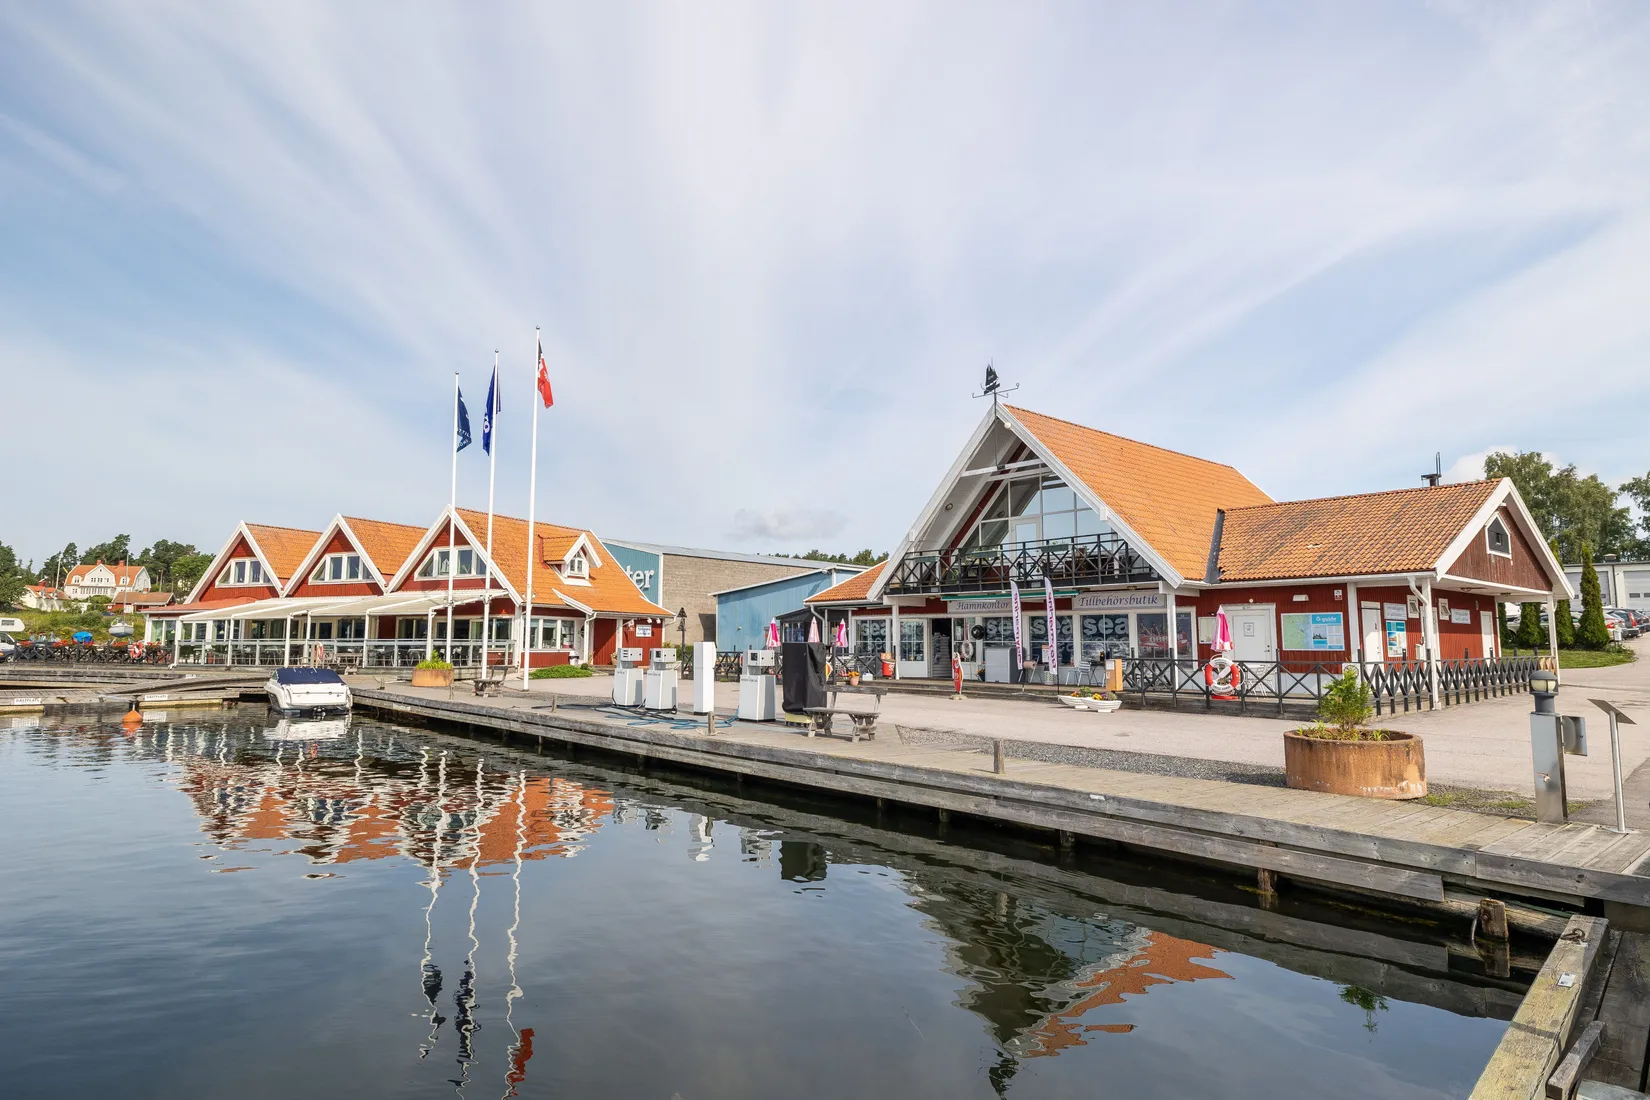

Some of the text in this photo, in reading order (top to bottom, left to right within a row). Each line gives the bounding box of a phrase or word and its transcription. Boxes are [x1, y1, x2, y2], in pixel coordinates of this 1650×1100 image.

[956, 601, 1010, 610] Hamnkontor
[1080, 593, 1158, 607] Tillbehörsbutik
[1083, 617, 1128, 635] sea
